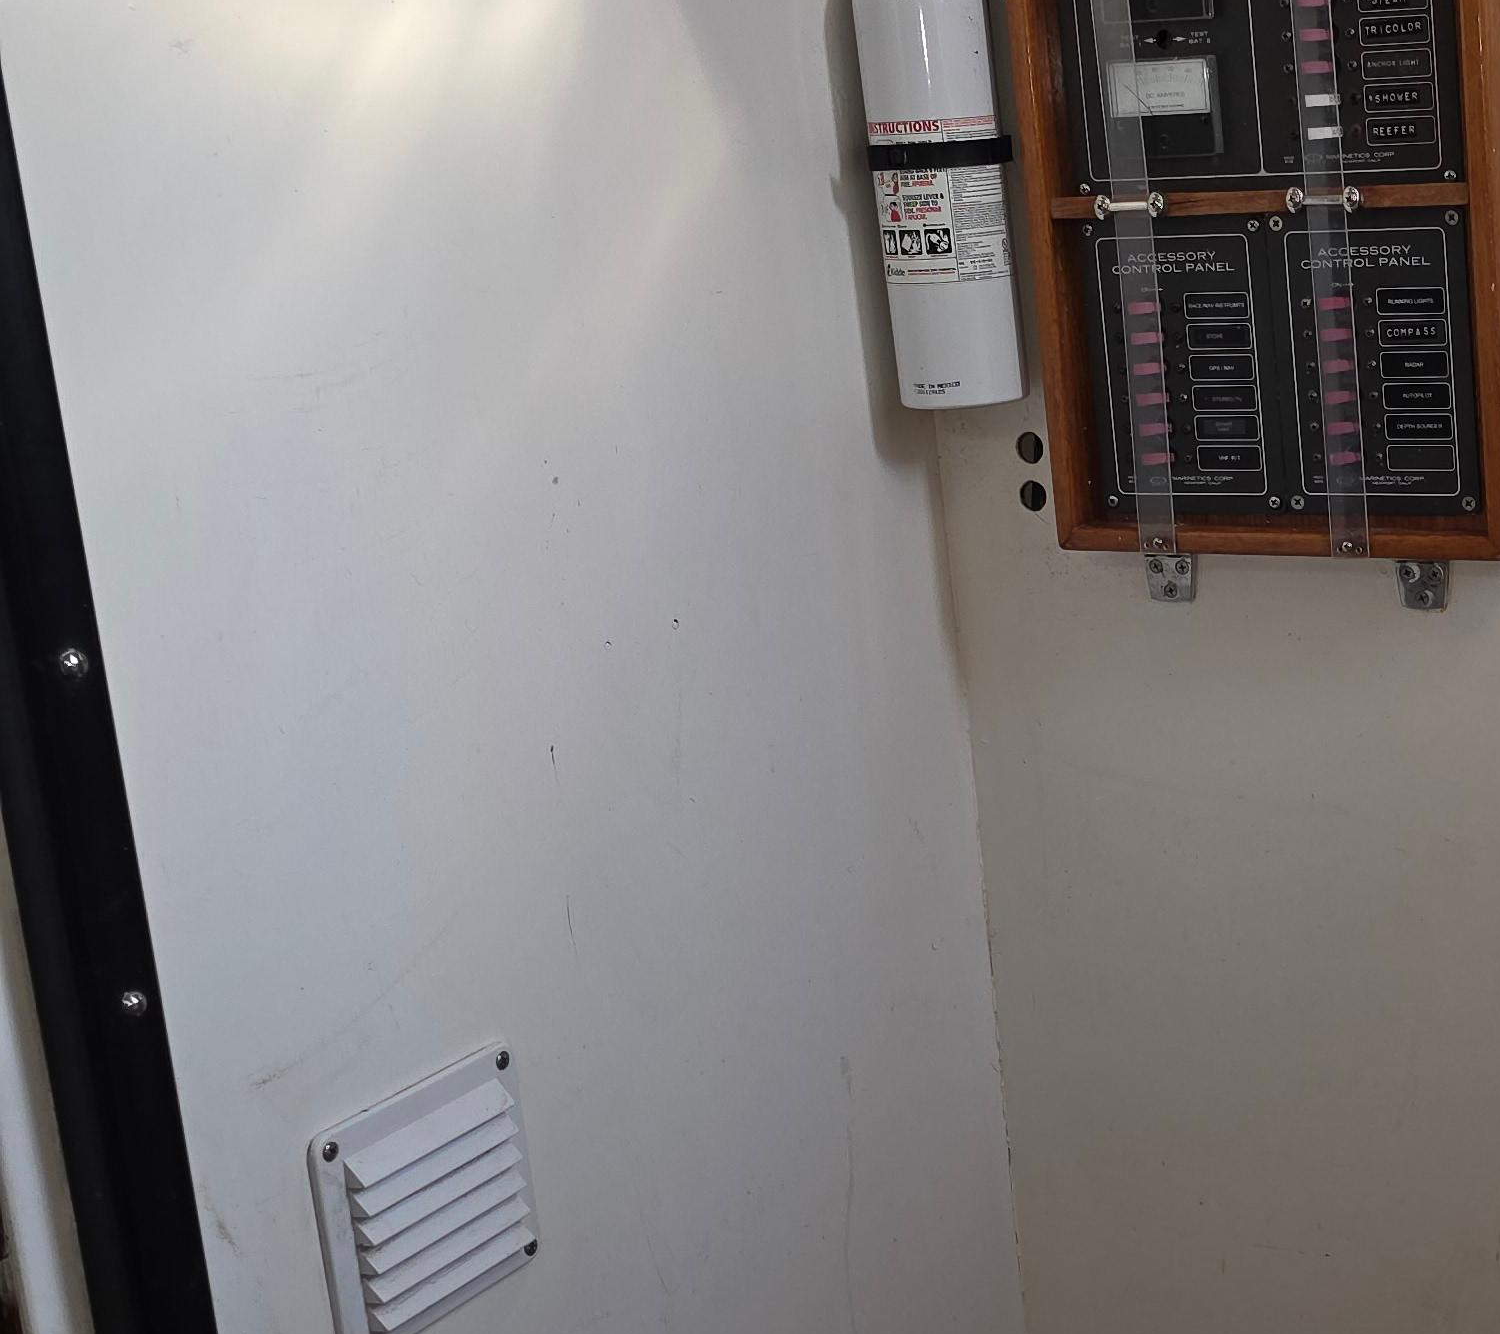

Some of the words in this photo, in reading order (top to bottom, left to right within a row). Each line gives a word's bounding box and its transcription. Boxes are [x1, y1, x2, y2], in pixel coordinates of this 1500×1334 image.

[1364, 21, 1421, 35] TRICOLOR
[1375, 91, 1418, 104] SHOWER
[1372, 125, 1415, 136] REEFER
[1127, 251, 1216, 262] ACCESSORY
[1318, 245, 1411, 257] ACCESSORY
[1111, 263, 1182, 275] CONTROL
[1186, 262, 1236, 273] PANEL
[1300, 257, 1375, 270] CONTROL
[1379, 256, 1431, 267] PANEL
[1386, 326, 1436, 337] COMPASS
